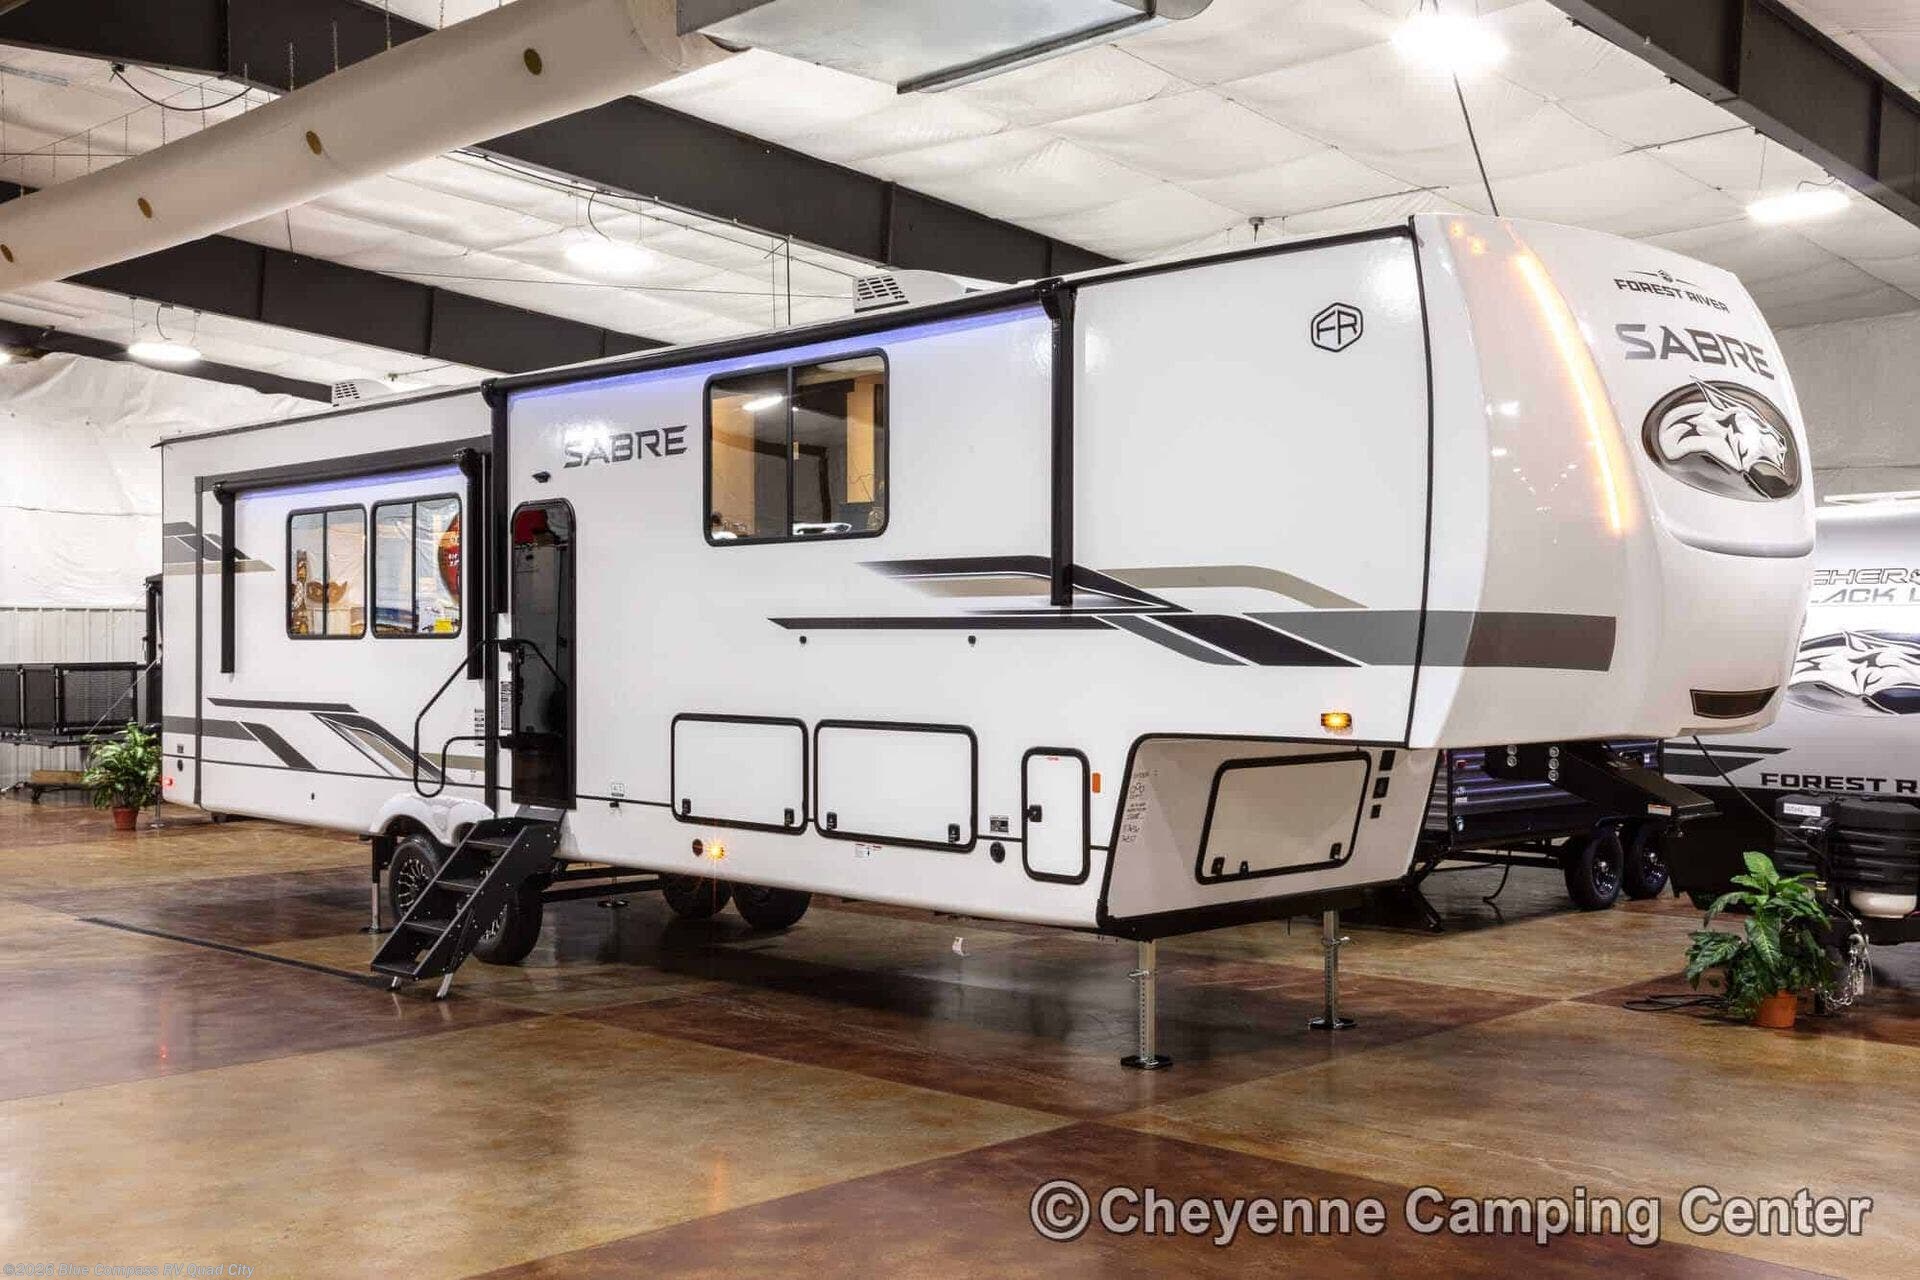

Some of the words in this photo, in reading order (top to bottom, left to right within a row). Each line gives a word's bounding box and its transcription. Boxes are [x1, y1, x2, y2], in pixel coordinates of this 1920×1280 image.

[1613, 277, 1684, 299] FOREST
[1685, 290, 1731, 314] RIVER
[1614, 323, 1776, 381] SABRE
[563, 424, 688, 469] SABRE
[1760, 772, 1888, 793] FOREST
